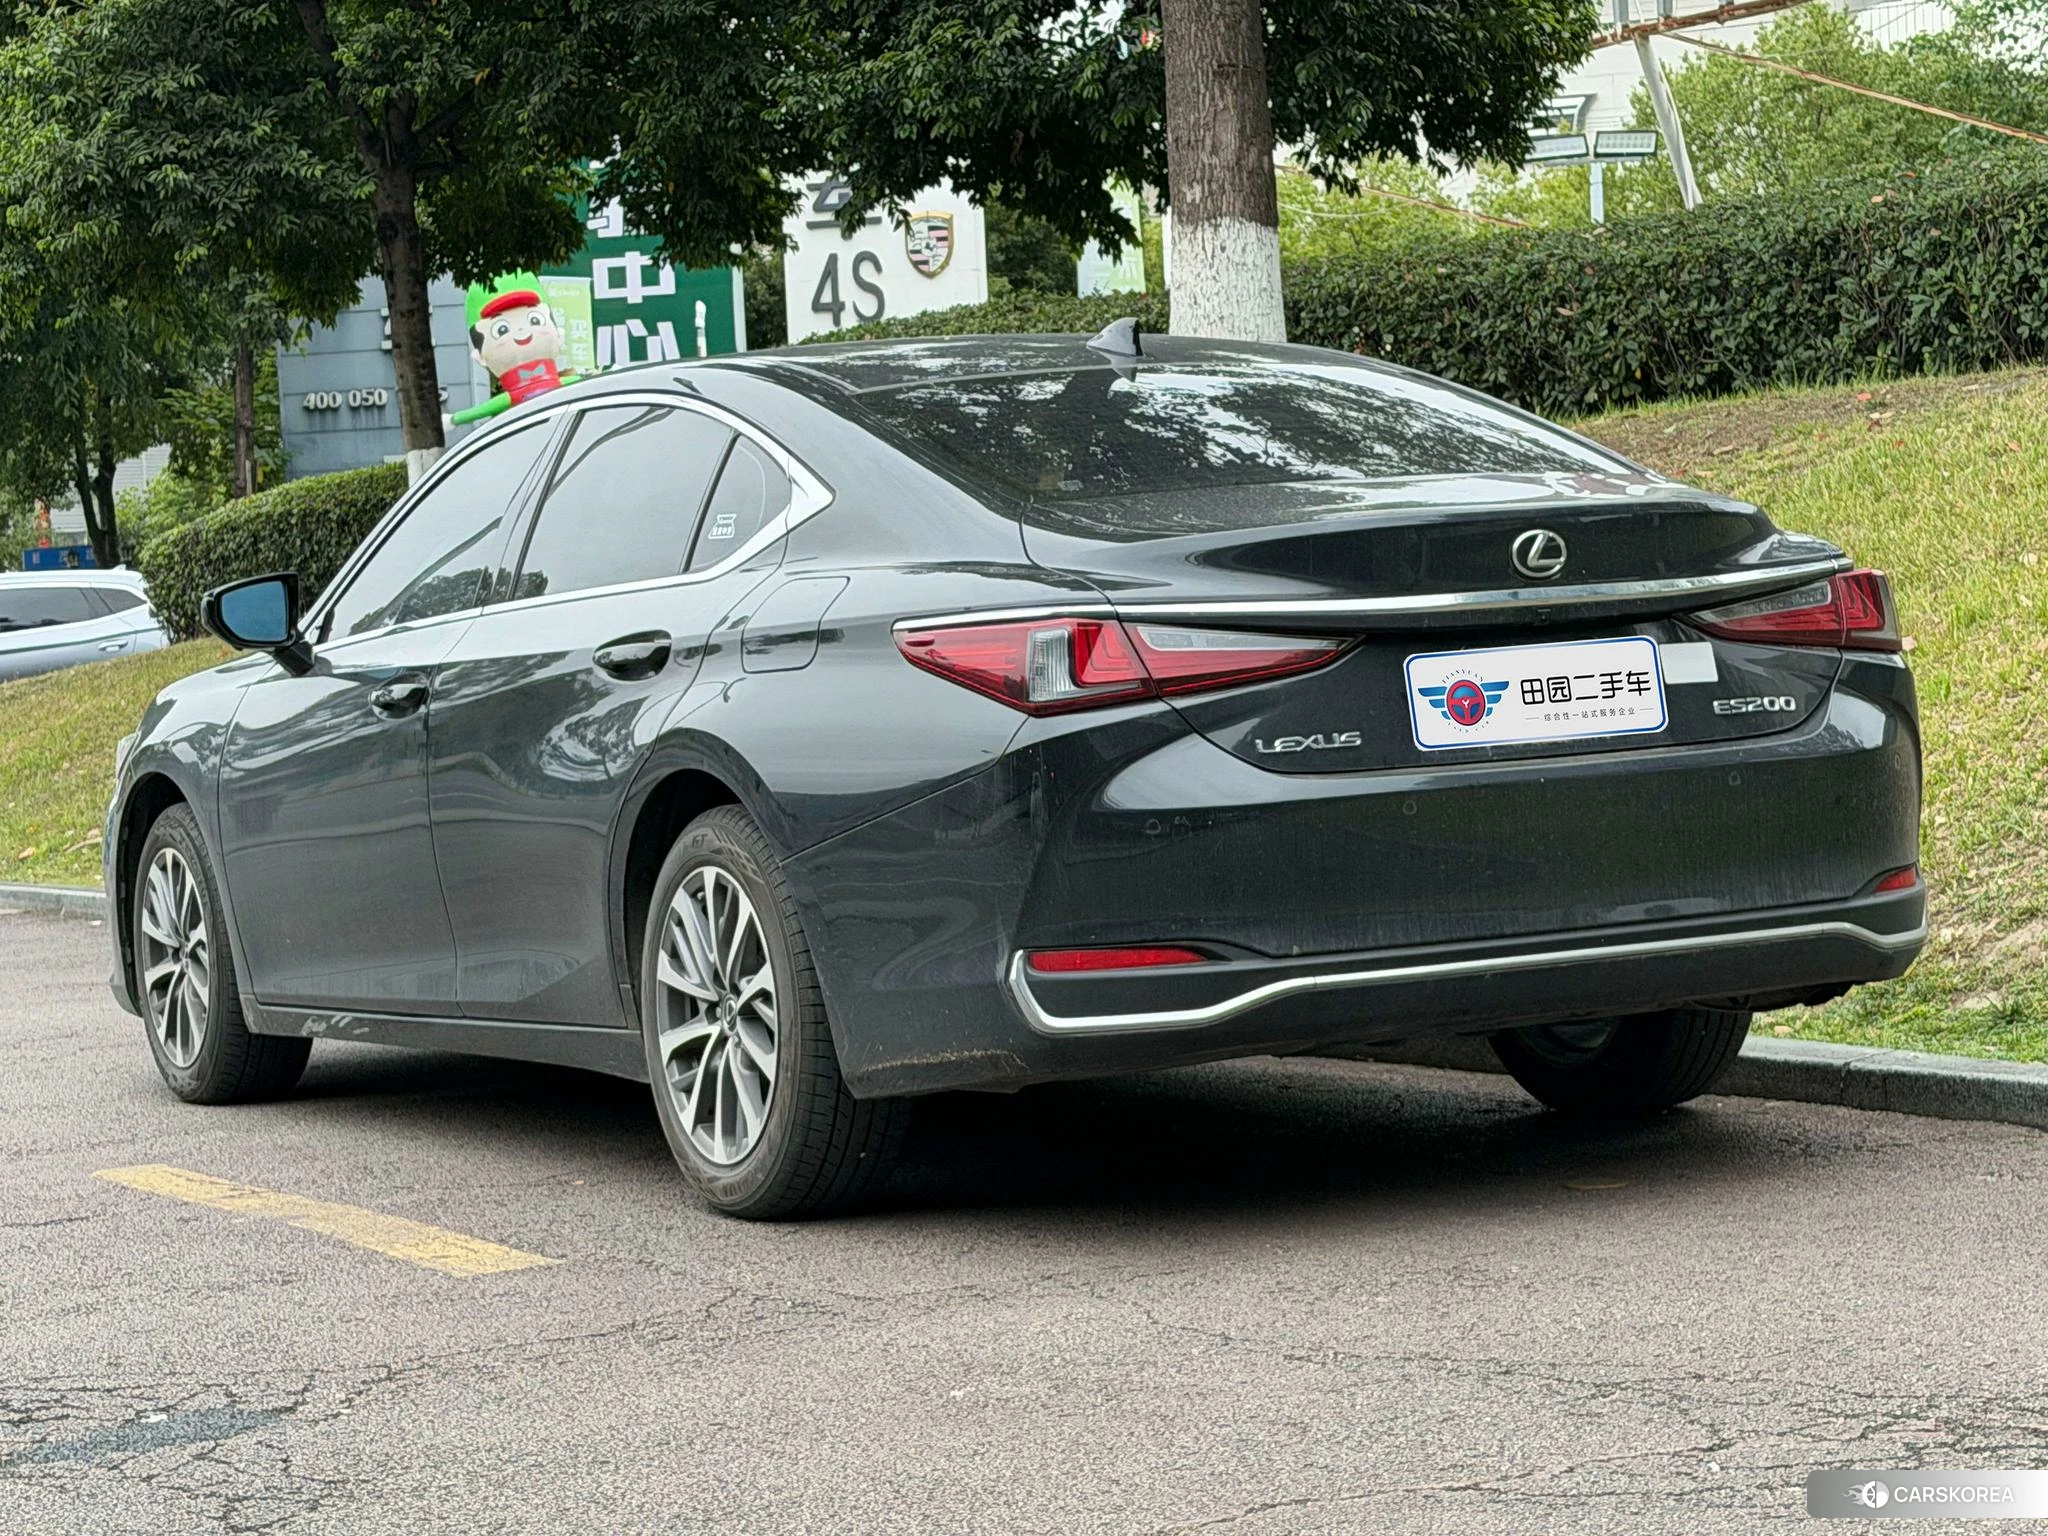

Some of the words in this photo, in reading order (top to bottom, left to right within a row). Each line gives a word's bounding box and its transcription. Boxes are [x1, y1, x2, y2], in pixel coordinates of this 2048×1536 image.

[811, 249, 886, 327] 4S
[302, 391, 343, 410] 400
[348, 388, 389, 407] 050
[1520, 670, 1651, 706] 田园二手车
[1543, 706, 1636, 722] 综合性一站式服务企业
[1713, 696, 1797, 715] ES200
[1255, 731, 1362, 753] LEXUS
